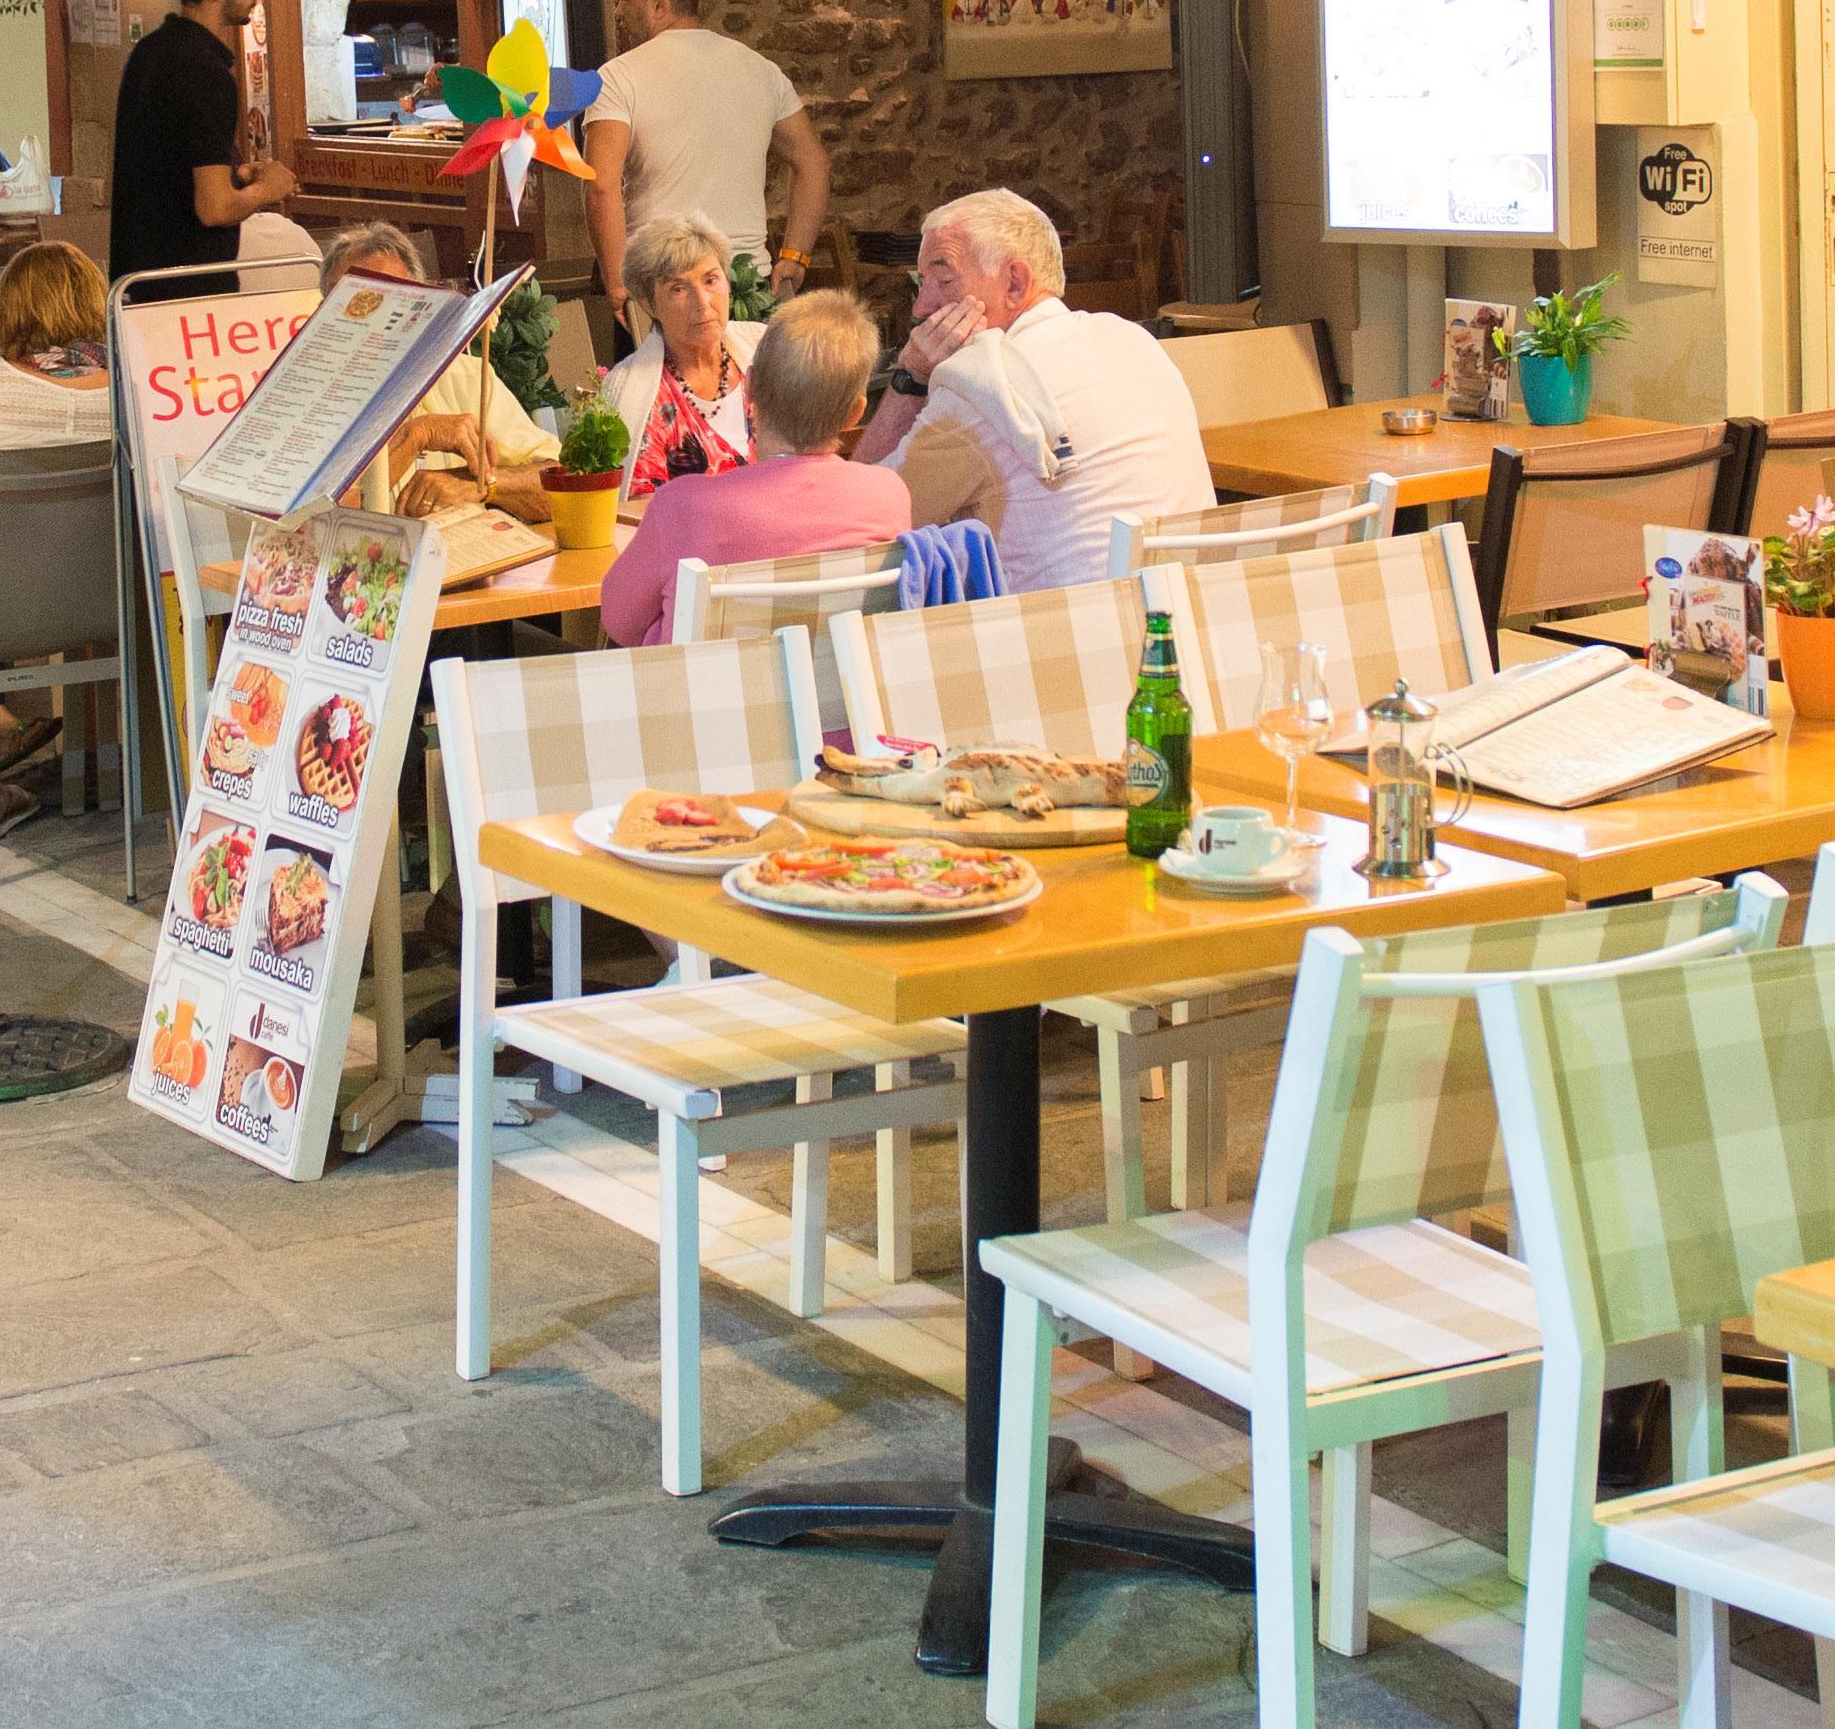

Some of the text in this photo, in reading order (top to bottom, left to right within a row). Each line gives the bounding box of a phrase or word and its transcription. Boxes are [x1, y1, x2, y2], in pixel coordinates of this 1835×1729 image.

[1664, 147, 1687, 160] Free
[1664, 200, 1688, 214] spot
[1640, 239, 1712, 258] Free internet
[236, 601, 304, 637] pizza fresh
[239, 624, 293, 654] in wood oven
[325, 634, 374, 667] salads
[211, 768, 253, 799] crepes
[1129, 762, 1162, 782] thos
[287, 792, 339, 828] waffles
[172, 915, 231, 959] spaghetti
[249, 946, 313, 992] mousaka
[263, 1014, 290, 1038] danesi
[150, 1068, 191, 1105] juices
[218, 1101, 270, 1143] coffees
